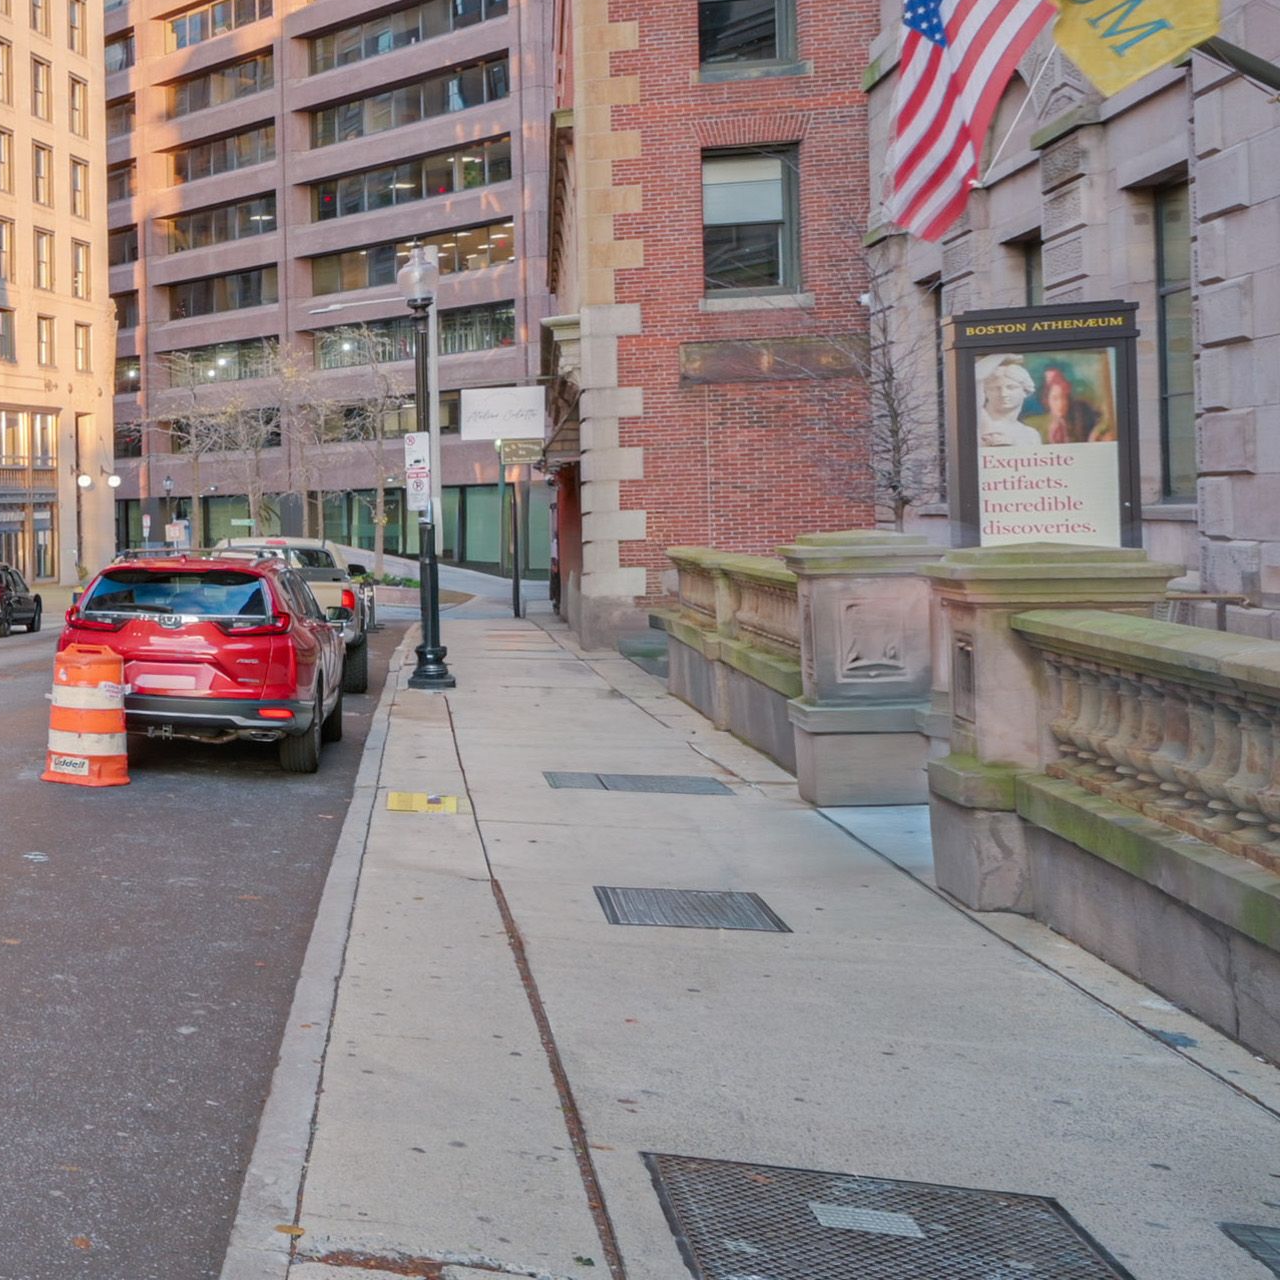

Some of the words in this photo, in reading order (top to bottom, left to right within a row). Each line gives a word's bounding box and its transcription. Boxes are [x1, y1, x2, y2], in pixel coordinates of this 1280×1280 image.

[965, 323, 1026, 336] BOSTON
[1032, 316, 1123, 331] ATHENÆUM
[982, 451, 1074, 472] Exquisite
[982, 475, 1068, 492] artifacts.
[984, 496, 1083, 513] Incredible
[983, 519, 1096, 536] discoveries.
